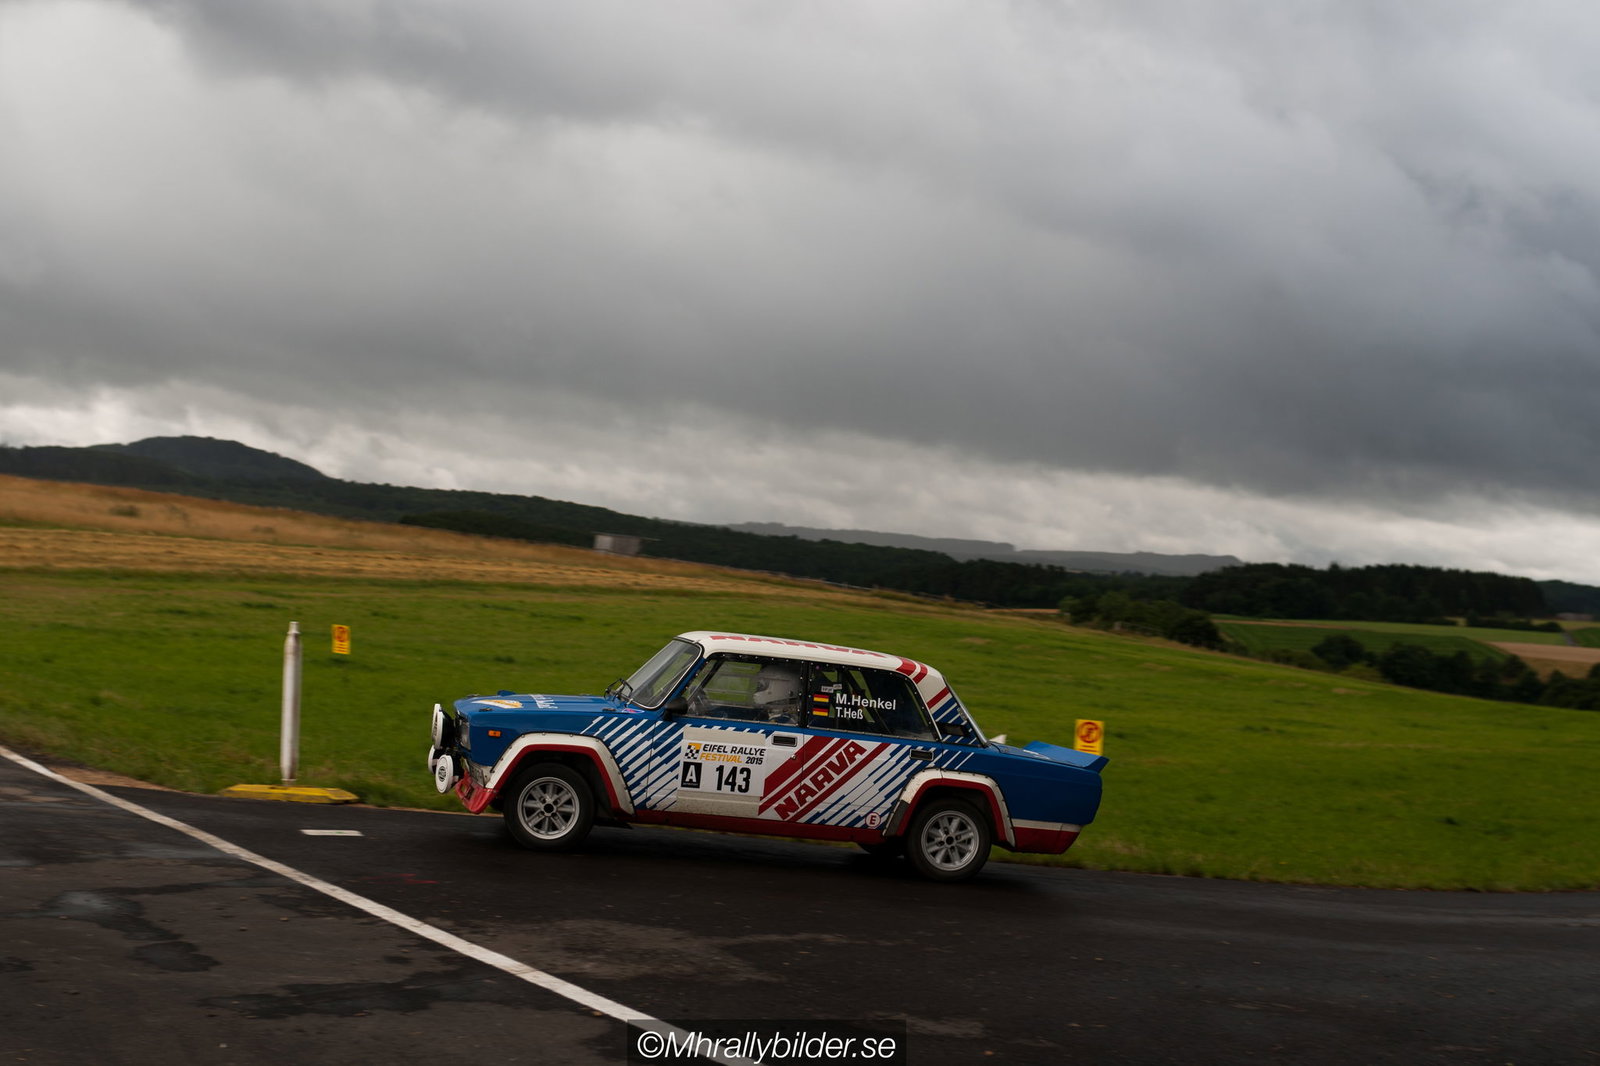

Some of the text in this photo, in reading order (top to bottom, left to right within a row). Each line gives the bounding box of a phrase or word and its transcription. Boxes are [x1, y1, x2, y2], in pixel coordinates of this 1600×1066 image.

[835, 693, 897, 711] M.Henkel
[835, 706, 864, 720] T.Heß
[702, 743, 767, 757] EIFEL RALLYE
[699, 752, 764, 765] FESTIVAL 2015
[685, 764, 698, 783] A
[715, 765, 752, 793] 143
[774, 740, 868, 821] NARVA
[869, 814, 877, 825] E
